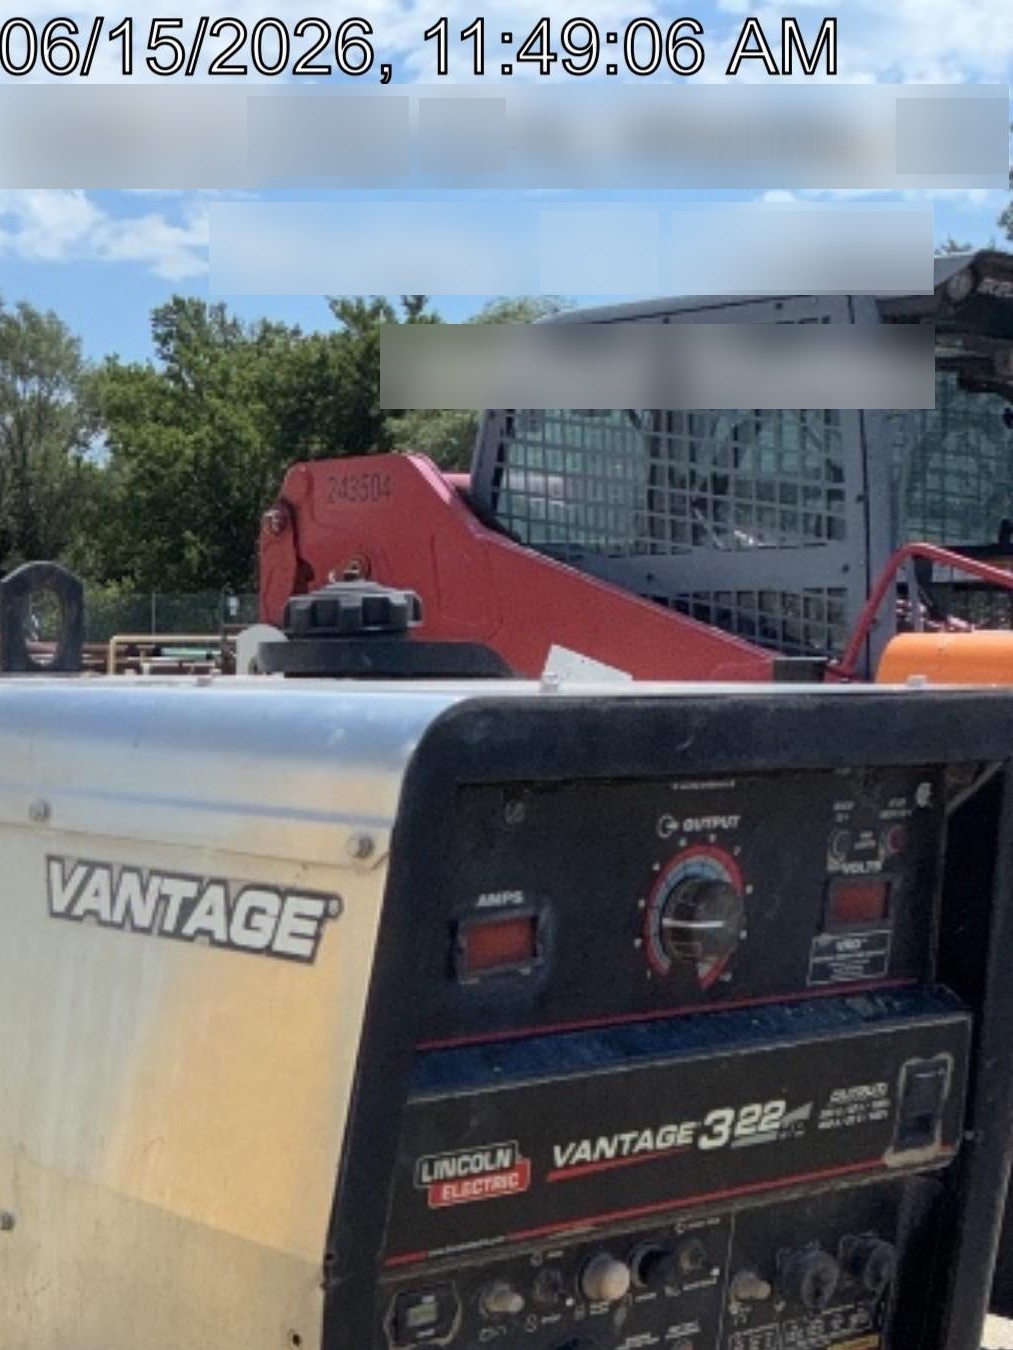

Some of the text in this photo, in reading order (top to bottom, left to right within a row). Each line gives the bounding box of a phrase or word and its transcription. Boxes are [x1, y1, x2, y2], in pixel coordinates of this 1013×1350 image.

[683, 815, 740, 832] OUTPUT
[476, 890, 524, 906] AMPS
[553, 1121, 695, 1168] VANTAGE
[699, 1100, 787, 1151] 322
[420, 1143, 513, 1183] LINCOLN
[441, 1173, 519, 1201] ELECTRIC
